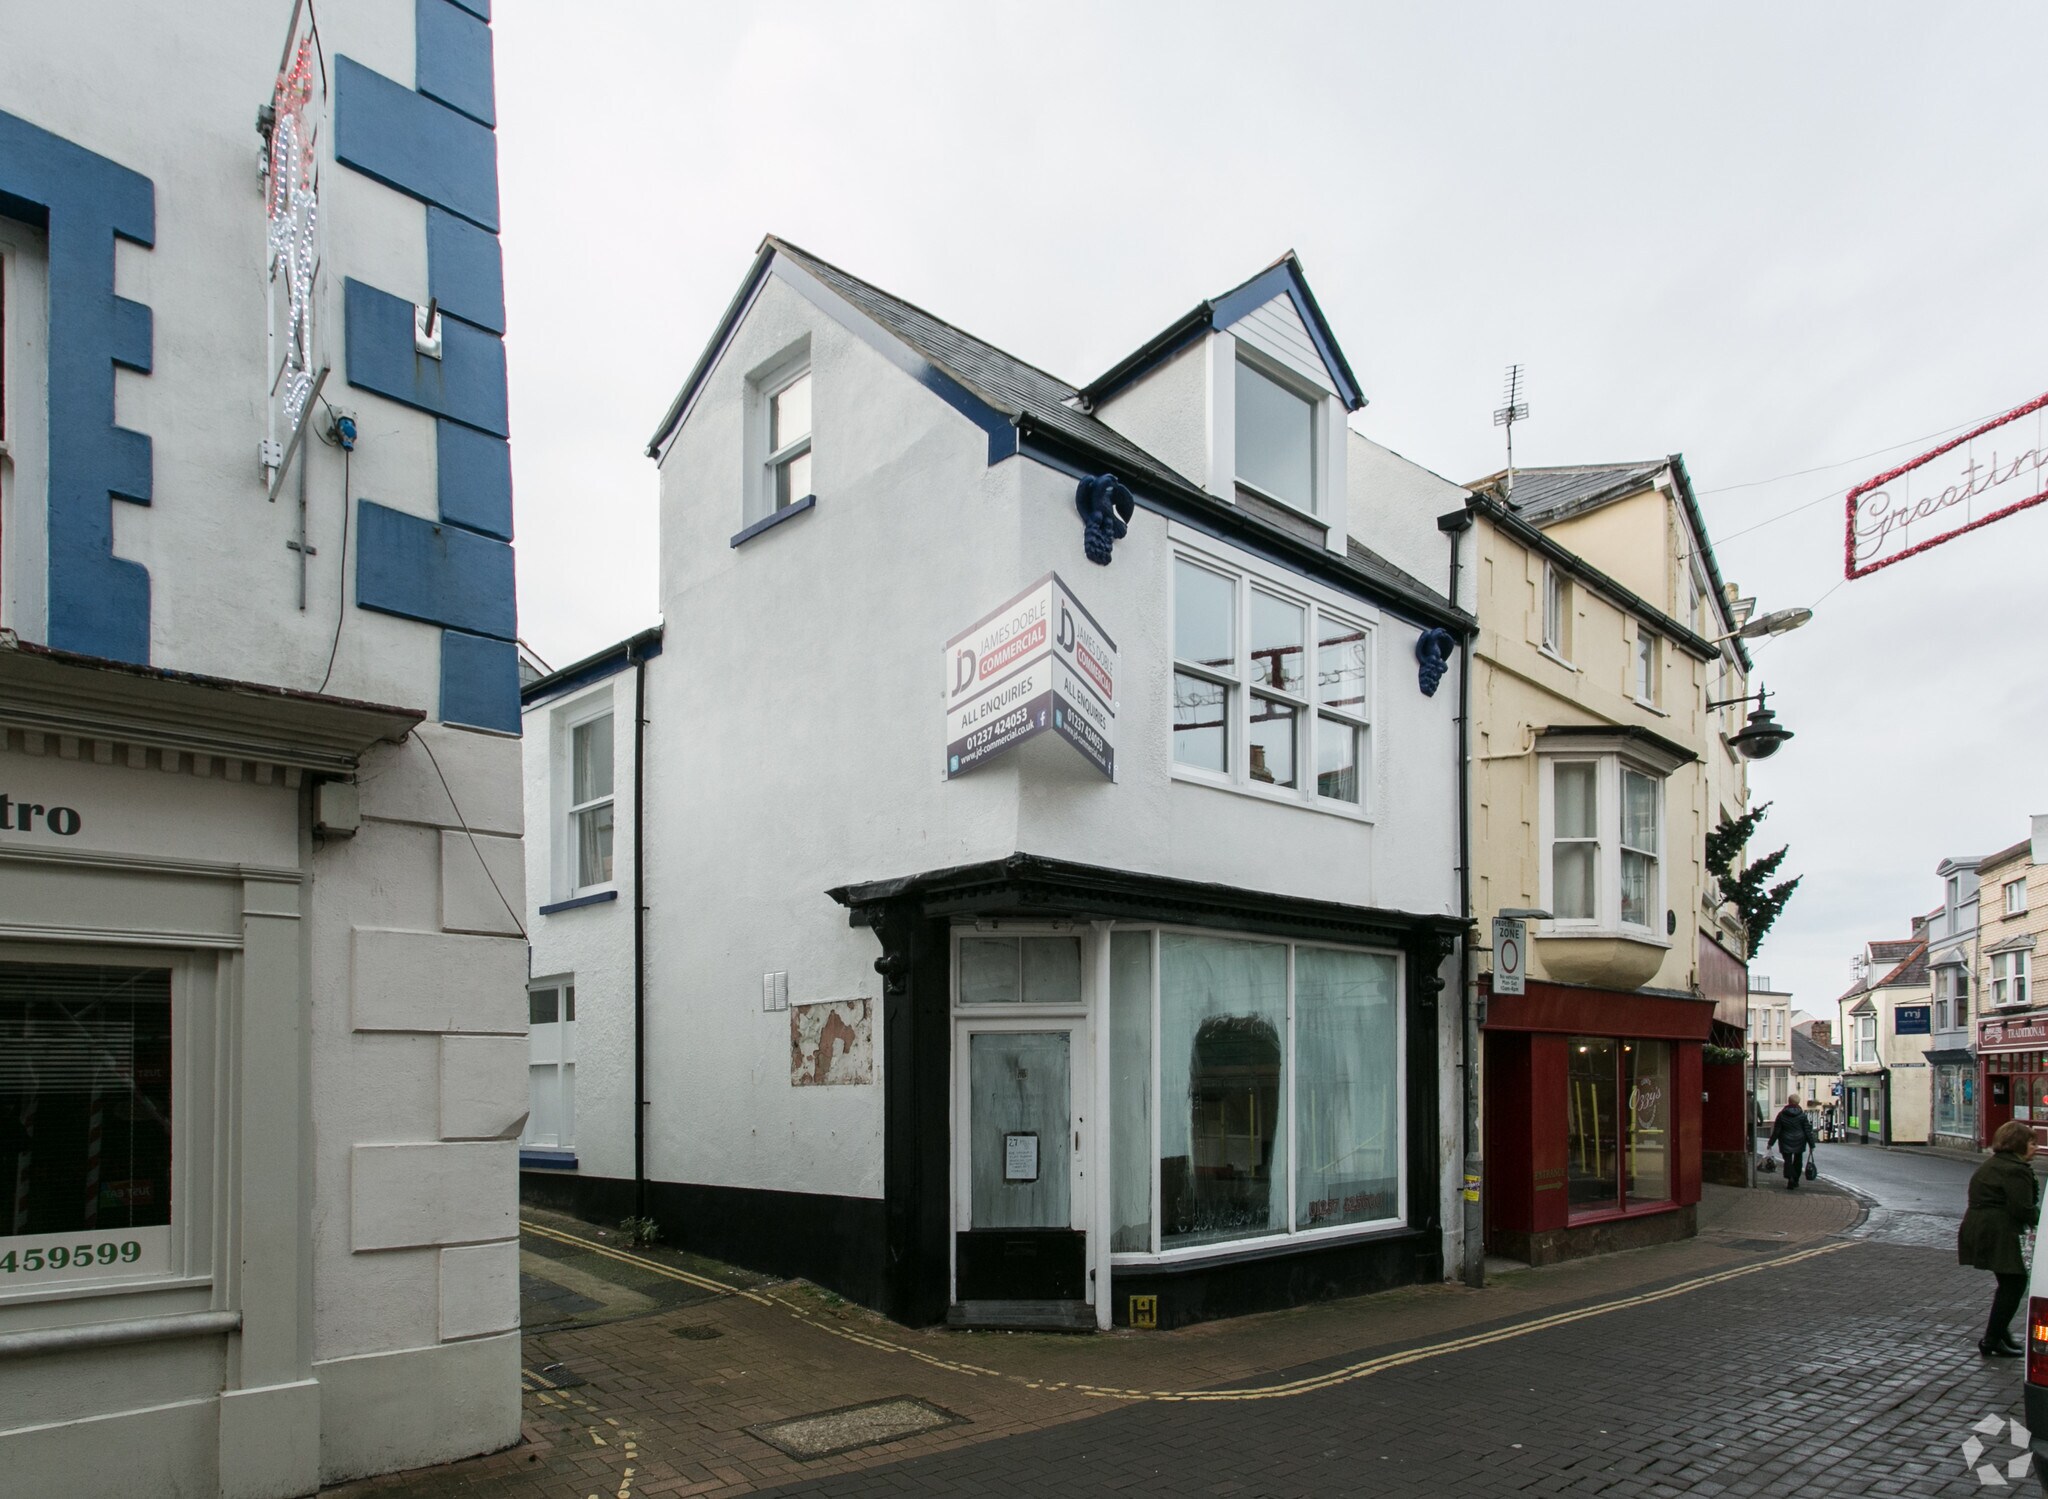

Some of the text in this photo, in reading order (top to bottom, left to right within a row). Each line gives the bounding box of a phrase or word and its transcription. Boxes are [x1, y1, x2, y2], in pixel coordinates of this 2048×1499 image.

[979, 599, 1046, 657] JAMES DOBLE
[981, 626, 1044, 675] COMMERCIAL
[1076, 624, 1113, 678] JAMES DOBLE
[1078, 647, 1112, 697] COMMERCIAL
[961, 676, 1033, 729] ALL ENQUIRIES
[1063, 677, 1107, 731] ALL ENQUIRIES
[1067, 708, 1085, 734] 01237
[960, 720, 1035, 764] www.jd-commercial.co.uk
[966, 707, 1028, 751] 01237 424053
[1495, 919, 1524, 930] PEDESTRIAN
[1499, 927, 1520, 939] ZONE
[1904, 1009, 1921, 1019] mj
[2007, 1026, 2046, 1039] TRADITIONAL
[1629, 1086, 1661, 1111] Ozzy's
[1008, 1138, 1018, 1148] 27
[0, 1241, 141, 1273] 459599
